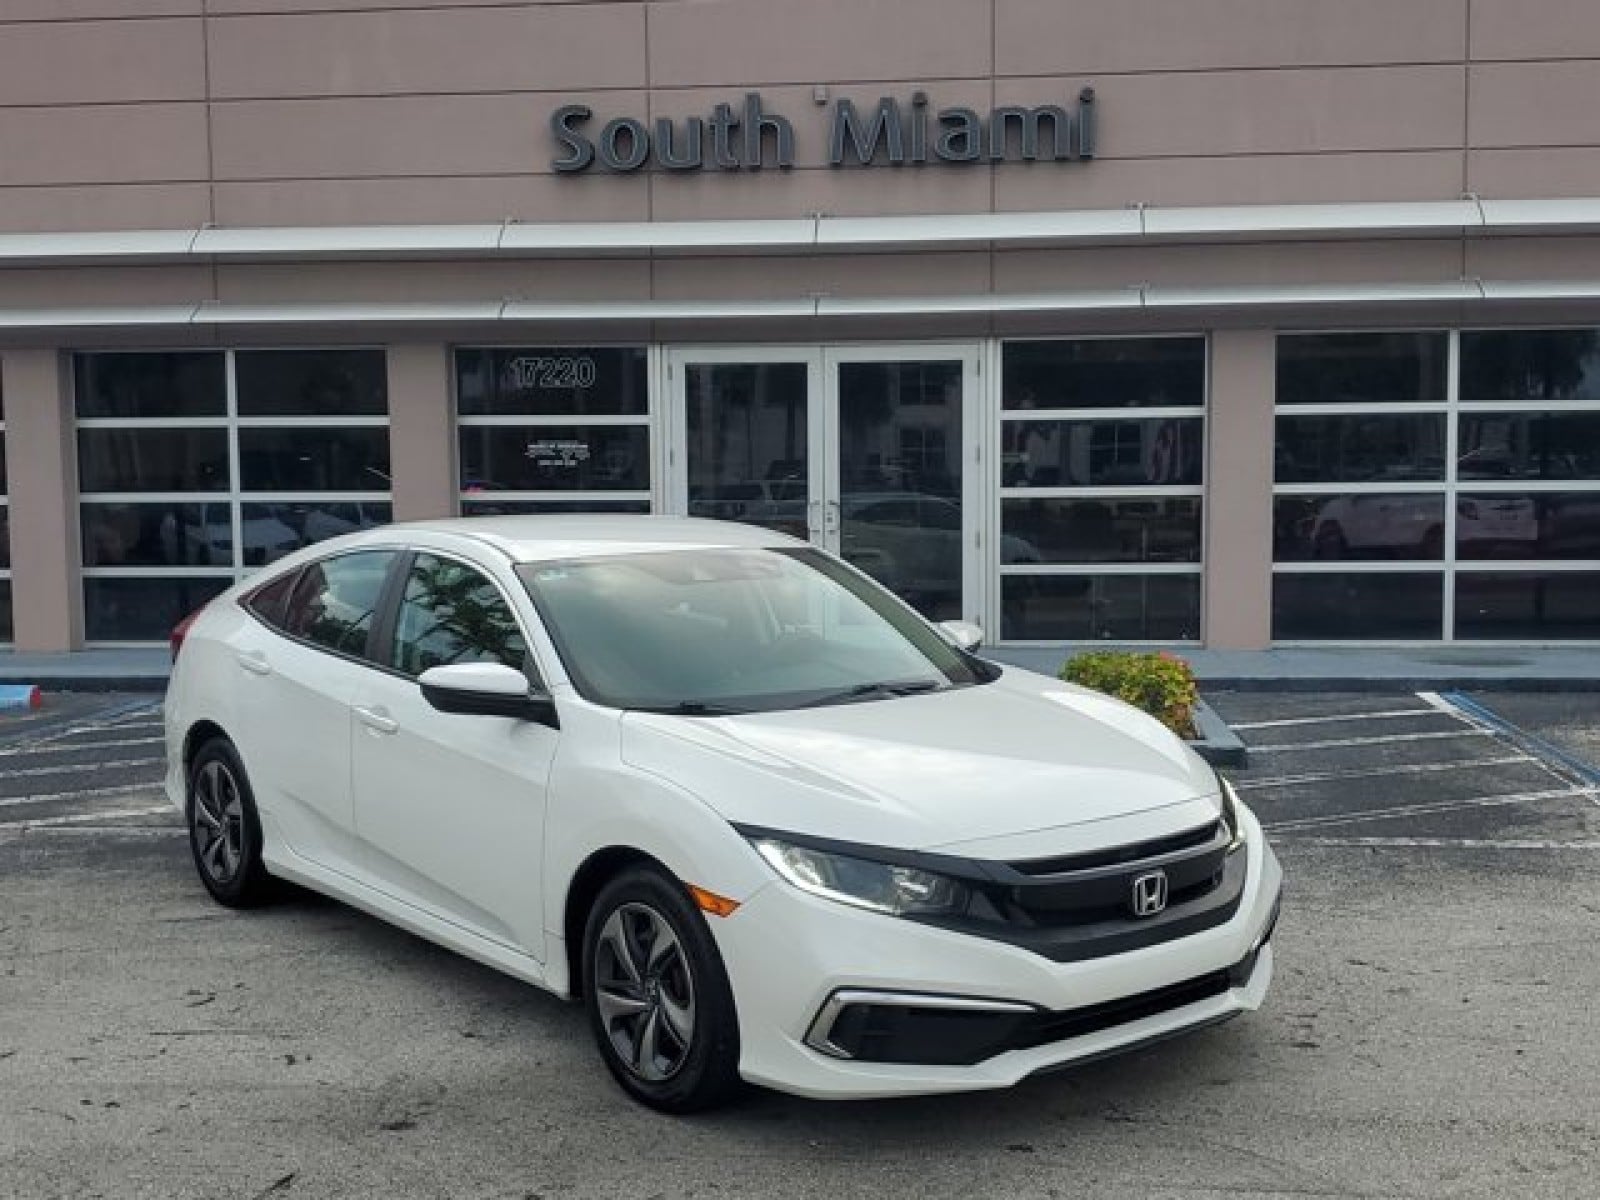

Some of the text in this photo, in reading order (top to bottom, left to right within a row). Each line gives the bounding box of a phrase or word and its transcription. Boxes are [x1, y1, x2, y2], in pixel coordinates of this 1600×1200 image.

[550, 87, 1096, 173] South Miami
[509, 357, 596, 389] 17220
